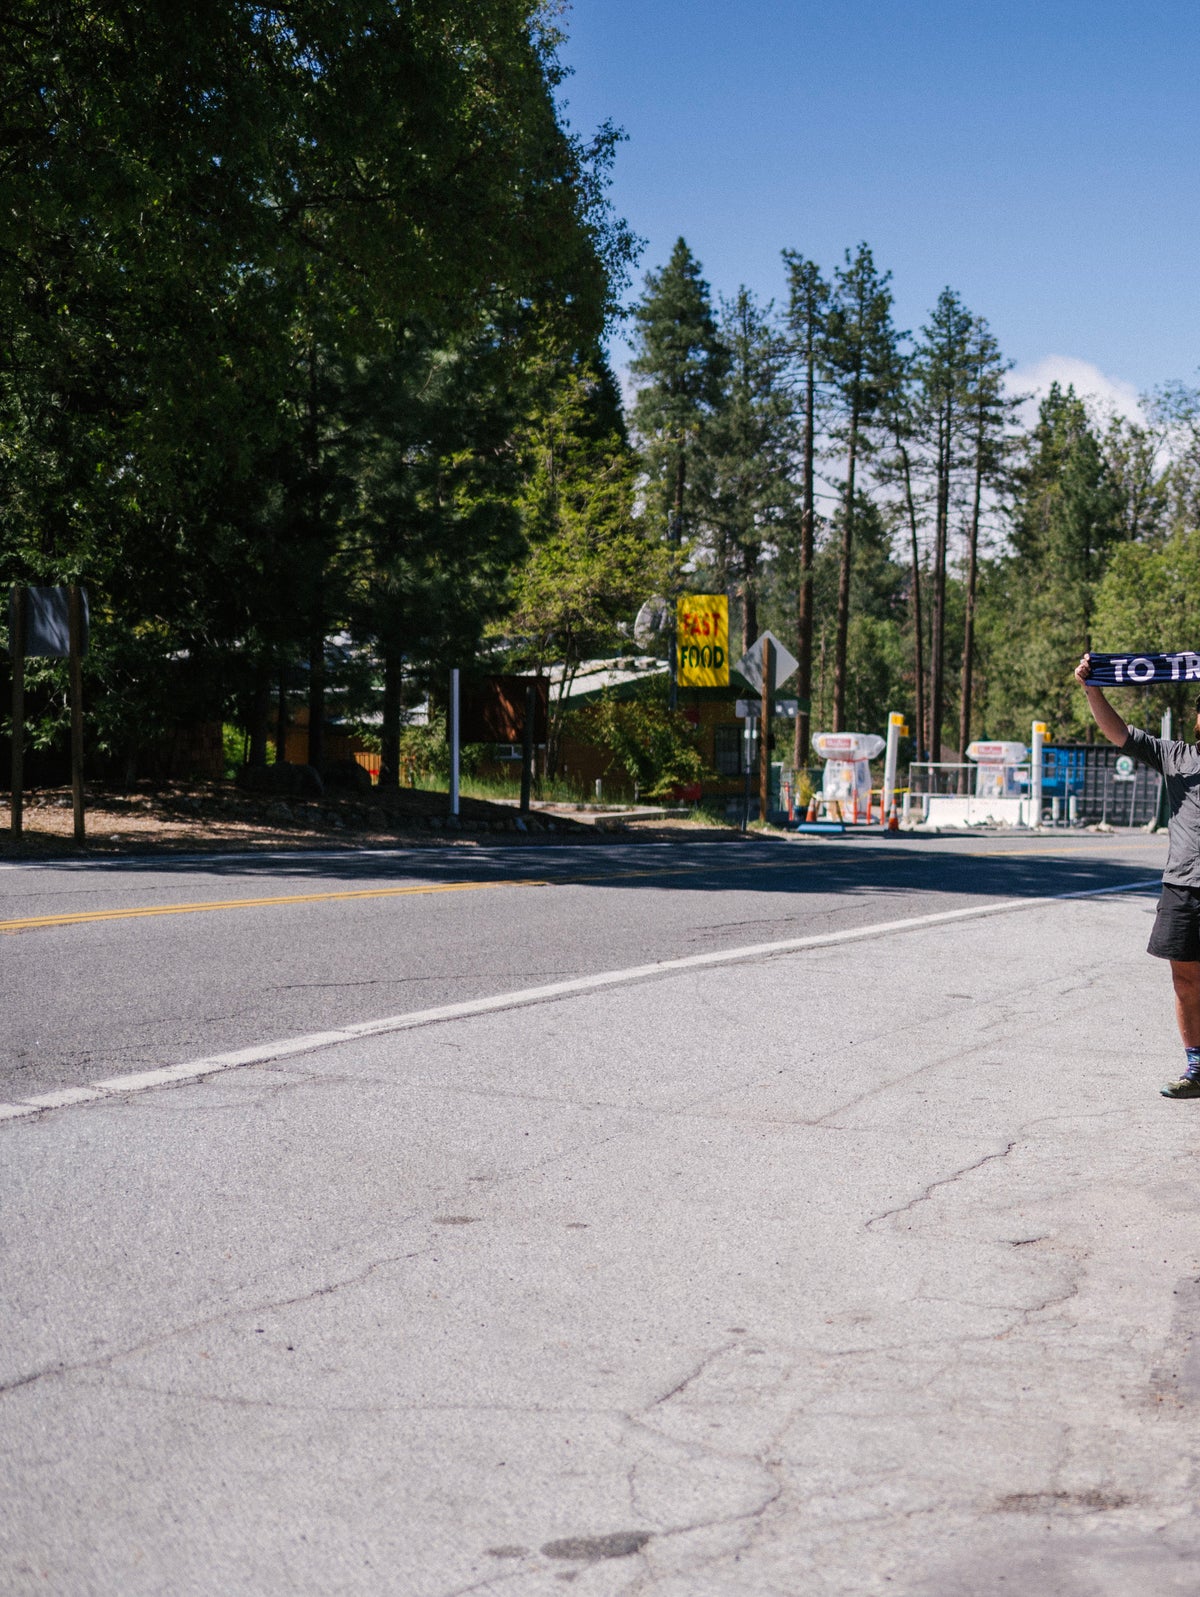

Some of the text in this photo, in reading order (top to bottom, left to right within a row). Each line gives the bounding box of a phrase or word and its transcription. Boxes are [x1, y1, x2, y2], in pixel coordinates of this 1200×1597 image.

[683, 612, 720, 637] FAST
[681, 645, 724, 669] FOOD
[1110, 657, 1155, 682] TO
